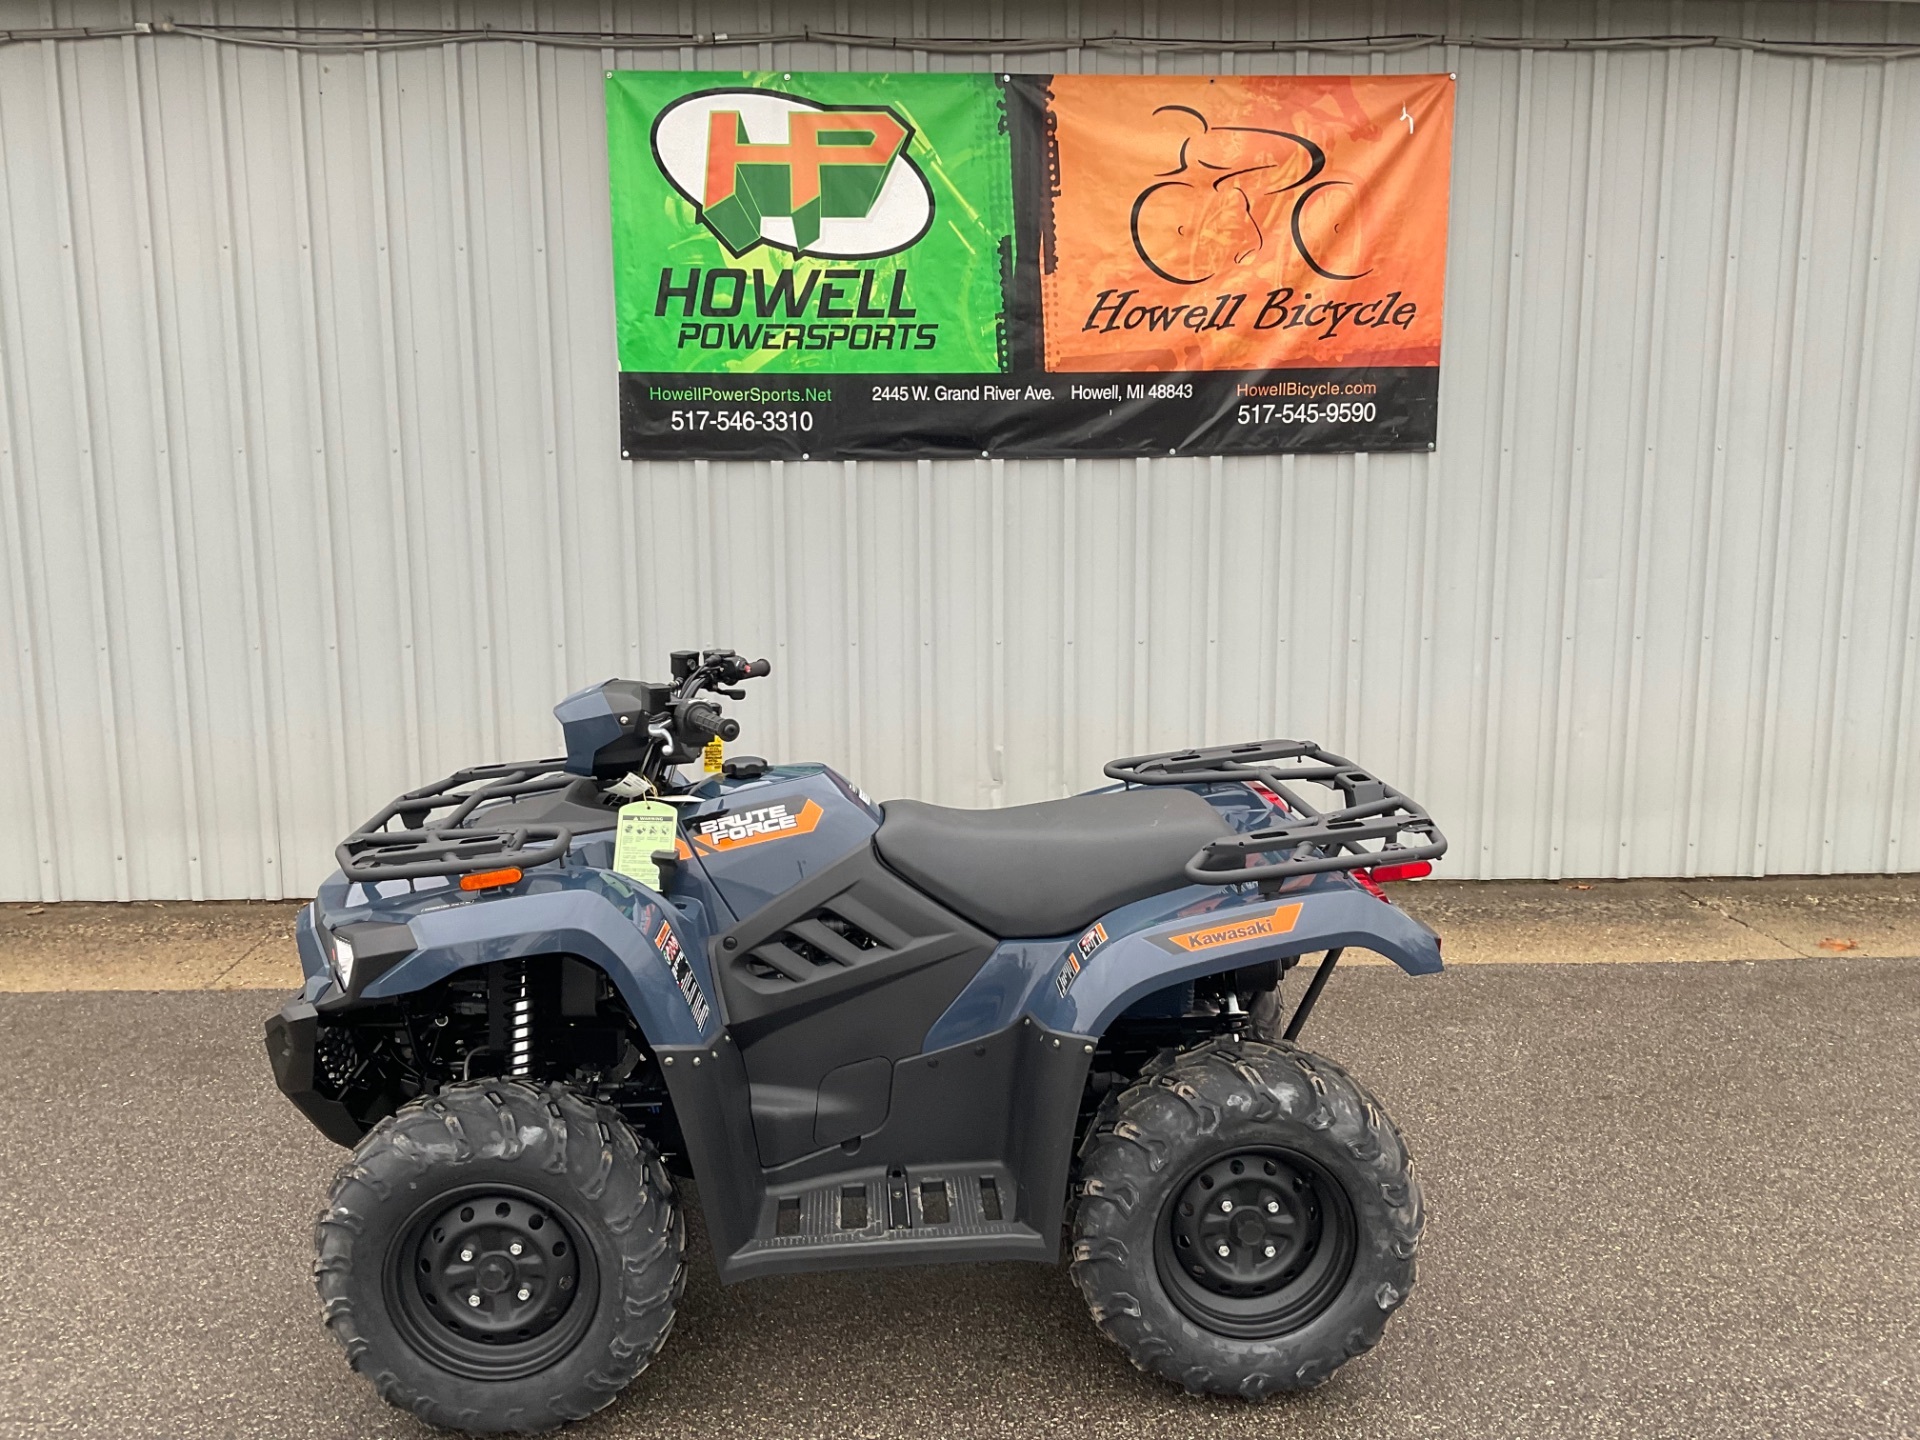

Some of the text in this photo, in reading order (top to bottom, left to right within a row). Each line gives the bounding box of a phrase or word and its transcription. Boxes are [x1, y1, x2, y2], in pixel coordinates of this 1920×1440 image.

[703, 110, 908, 213] HP
[654, 267, 917, 318] HOWELL
[1082, 287, 1417, 340] Howell Bicycle
[677, 323, 939, 350] POWERSPORTS
[649, 386, 832, 404] HowellPowerSports.Net
[872, 386, 1055, 401] 2445 W. Grand River Ave.
[1071, 384, 1193, 402] Howell, MI 48843
[1236, 381, 1377, 398] HowellBicycle.com
[670, 410, 814, 432] 517-546-3310
[1237, 402, 1377, 424] 517-545-9590
[700, 804, 788, 833] BRUTE
[712, 814, 799, 844] FORCE
[1188, 919, 1273, 948] Kawasaki
